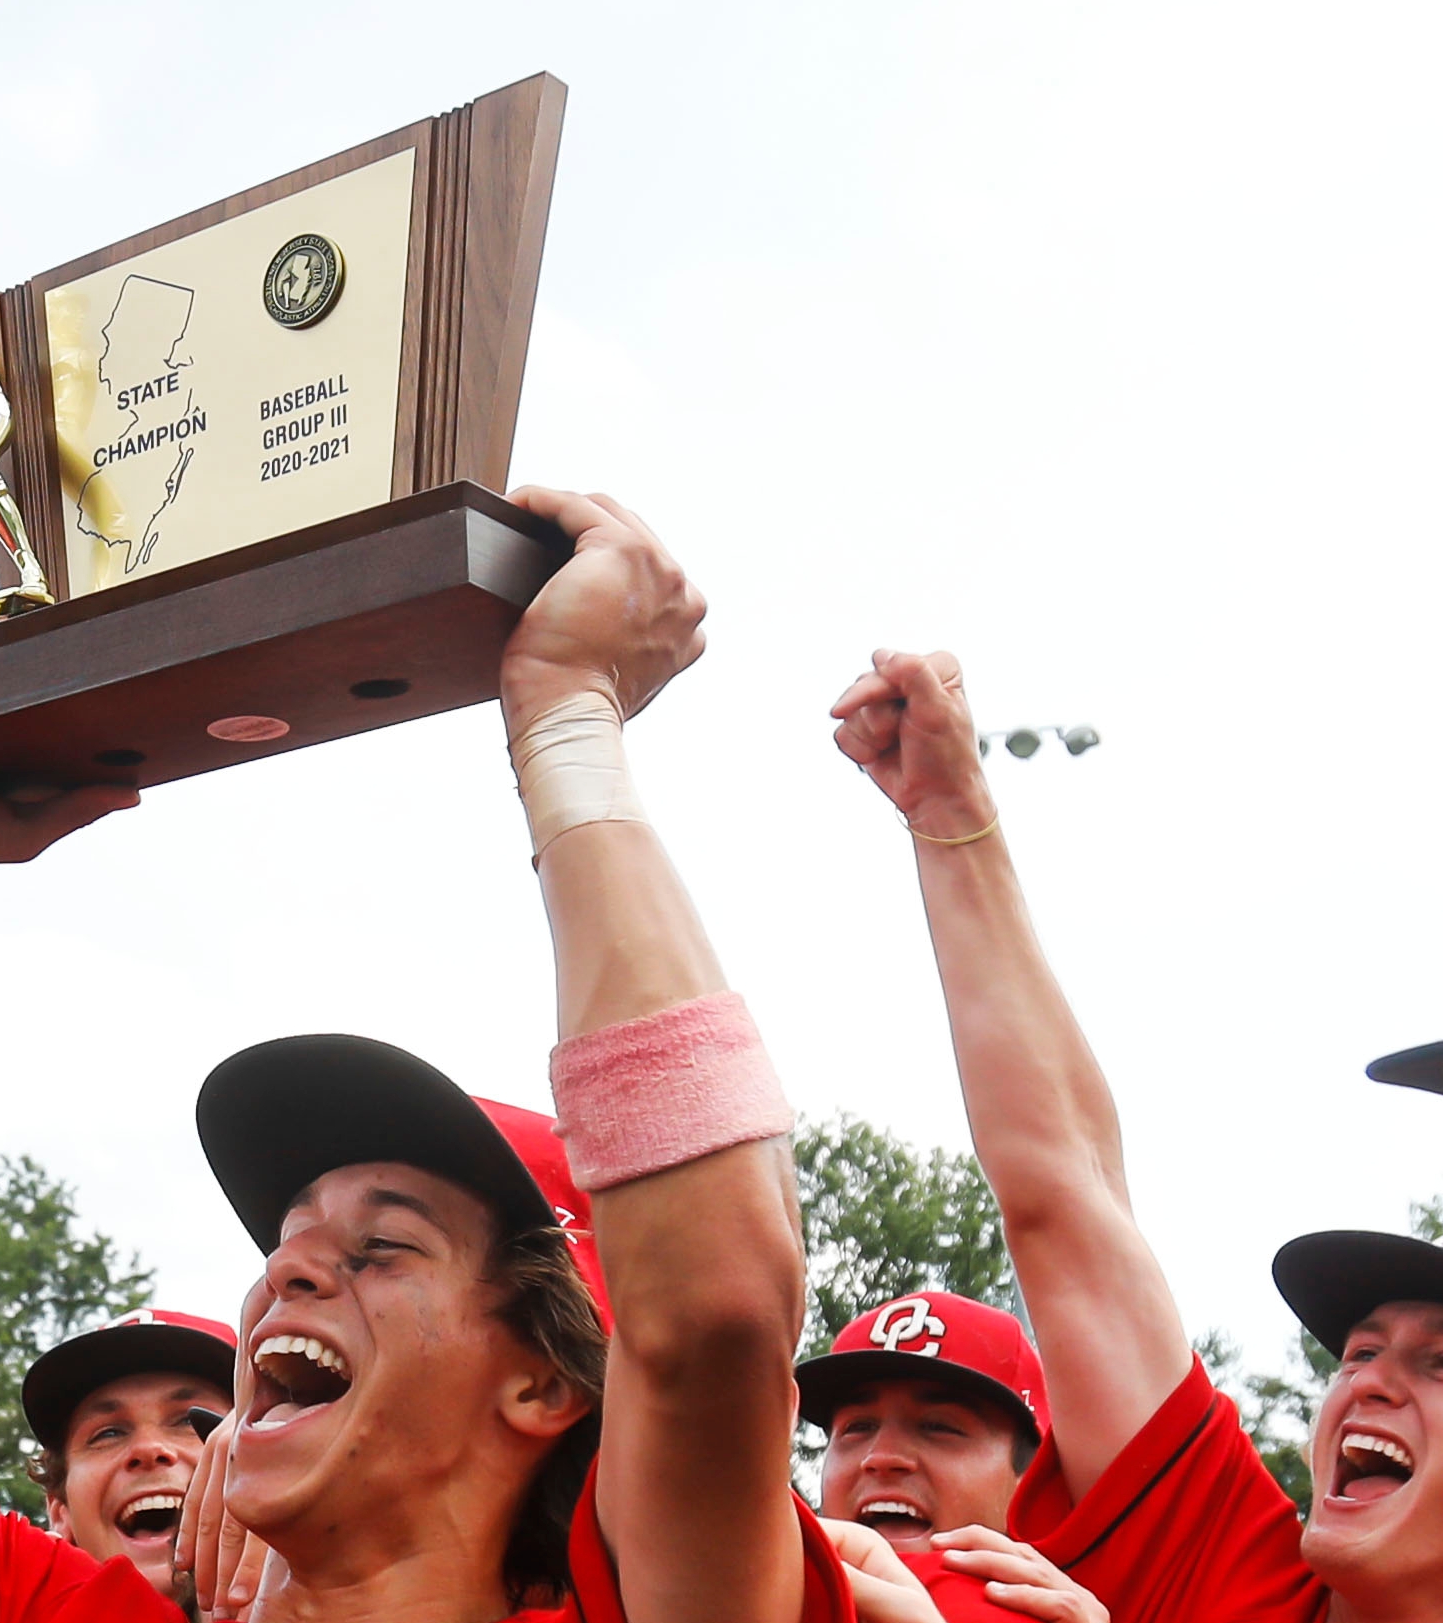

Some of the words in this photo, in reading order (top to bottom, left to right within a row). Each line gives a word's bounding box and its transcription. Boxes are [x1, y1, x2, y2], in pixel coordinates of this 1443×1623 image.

[117, 371, 180, 410] STATE
[260, 374, 349, 421] BASEBALL
[93, 410, 207, 468] CHAMPION
[263, 412, 324, 450] GROUP
[330, 404, 347, 428] III
[260, 434, 350, 482] 2020-2021
[869, 1297, 947, 1358] OC
